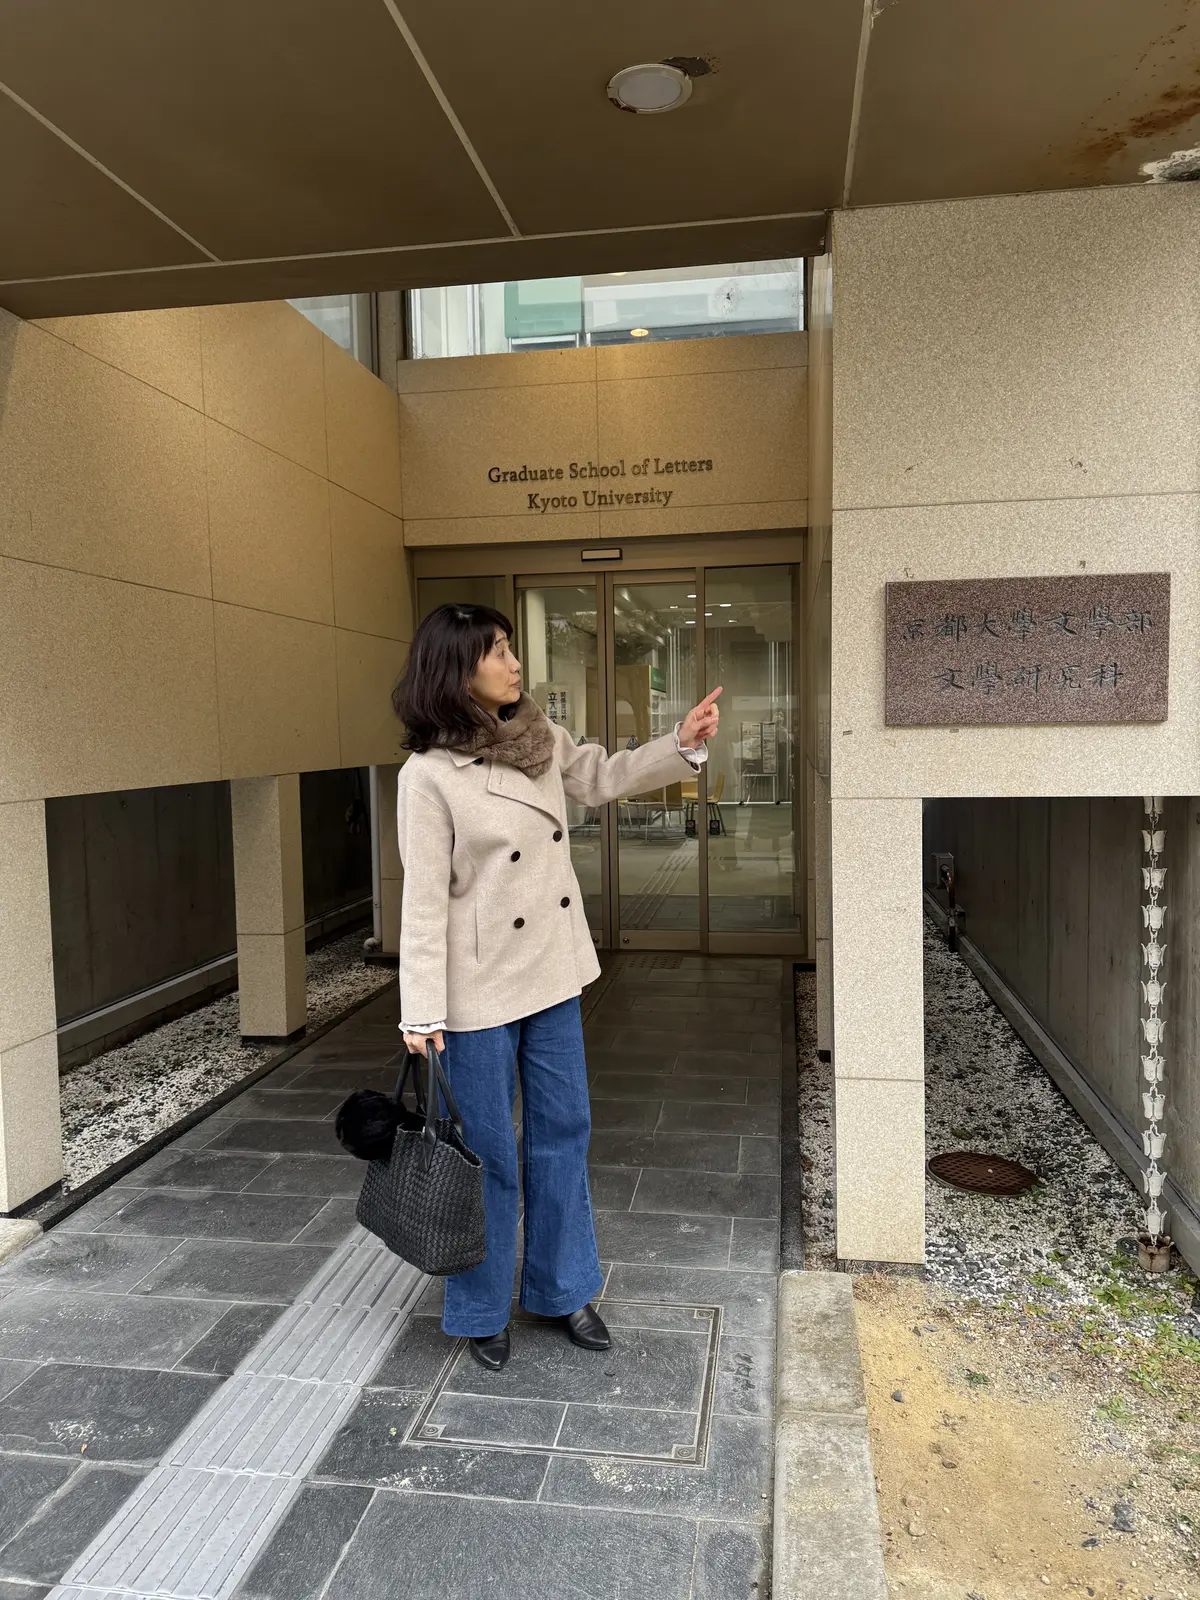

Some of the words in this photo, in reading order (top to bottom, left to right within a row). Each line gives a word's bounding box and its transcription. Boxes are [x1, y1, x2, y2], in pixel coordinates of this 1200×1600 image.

[488, 465, 564, 483] Graduate
[569, 461, 626, 479] School
[631, 458, 650, 476] of
[653, 457, 713, 475] Letters
[527, 493, 578, 513] Kyoto
[582, 487, 673, 507] University
[902, 605, 1153, 642] 京都大學文學部
[931, 661, 1124, 696] 文學研究科
